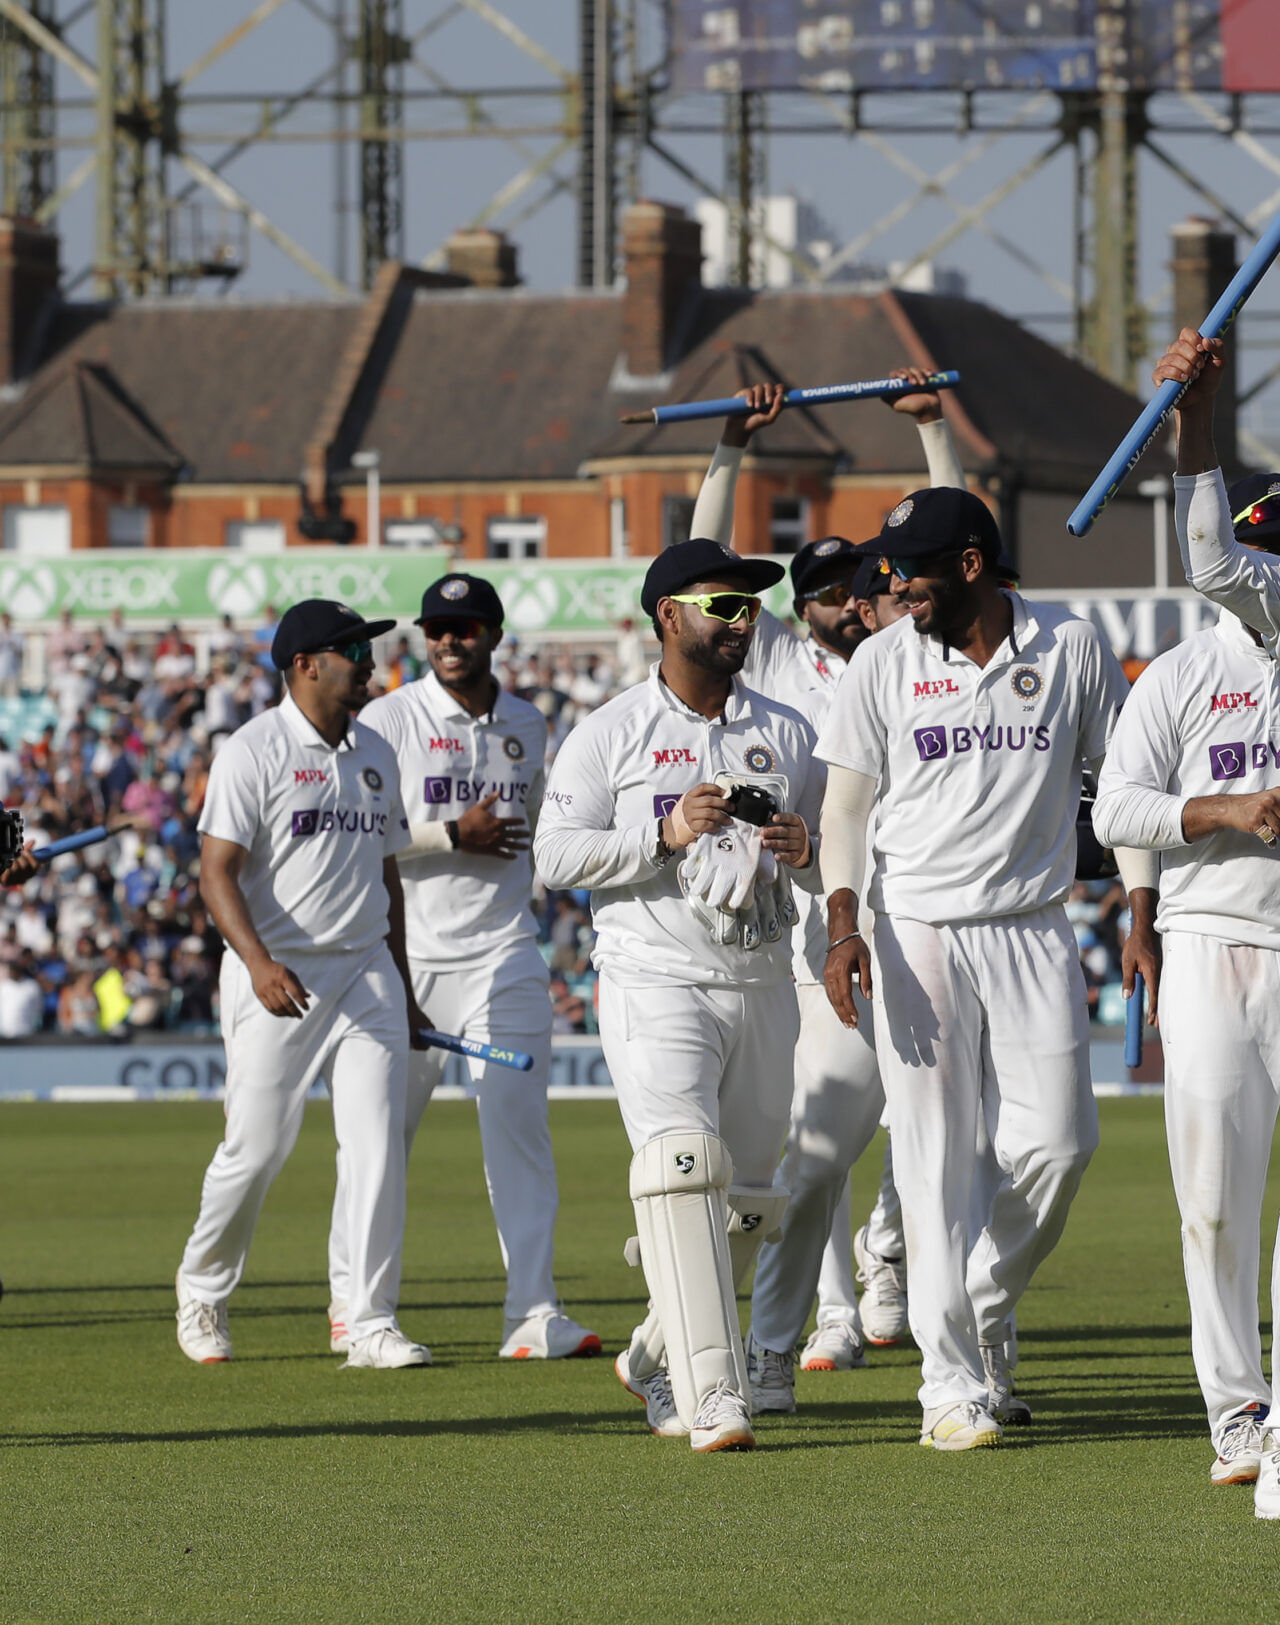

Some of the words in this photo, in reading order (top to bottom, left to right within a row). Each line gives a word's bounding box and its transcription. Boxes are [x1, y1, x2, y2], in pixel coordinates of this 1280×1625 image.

[62, 566, 180, 608] XBOX
[274, 563, 392, 607] XBOX
[914, 679, 959, 696] MPL
[1211, 692, 1258, 711] MPL
[952, 725, 1051, 753] BYJU'S
[653, 749, 697, 764] MPL
[293, 769, 329, 782] MPL
[320, 810, 388, 836] BYJU'S
